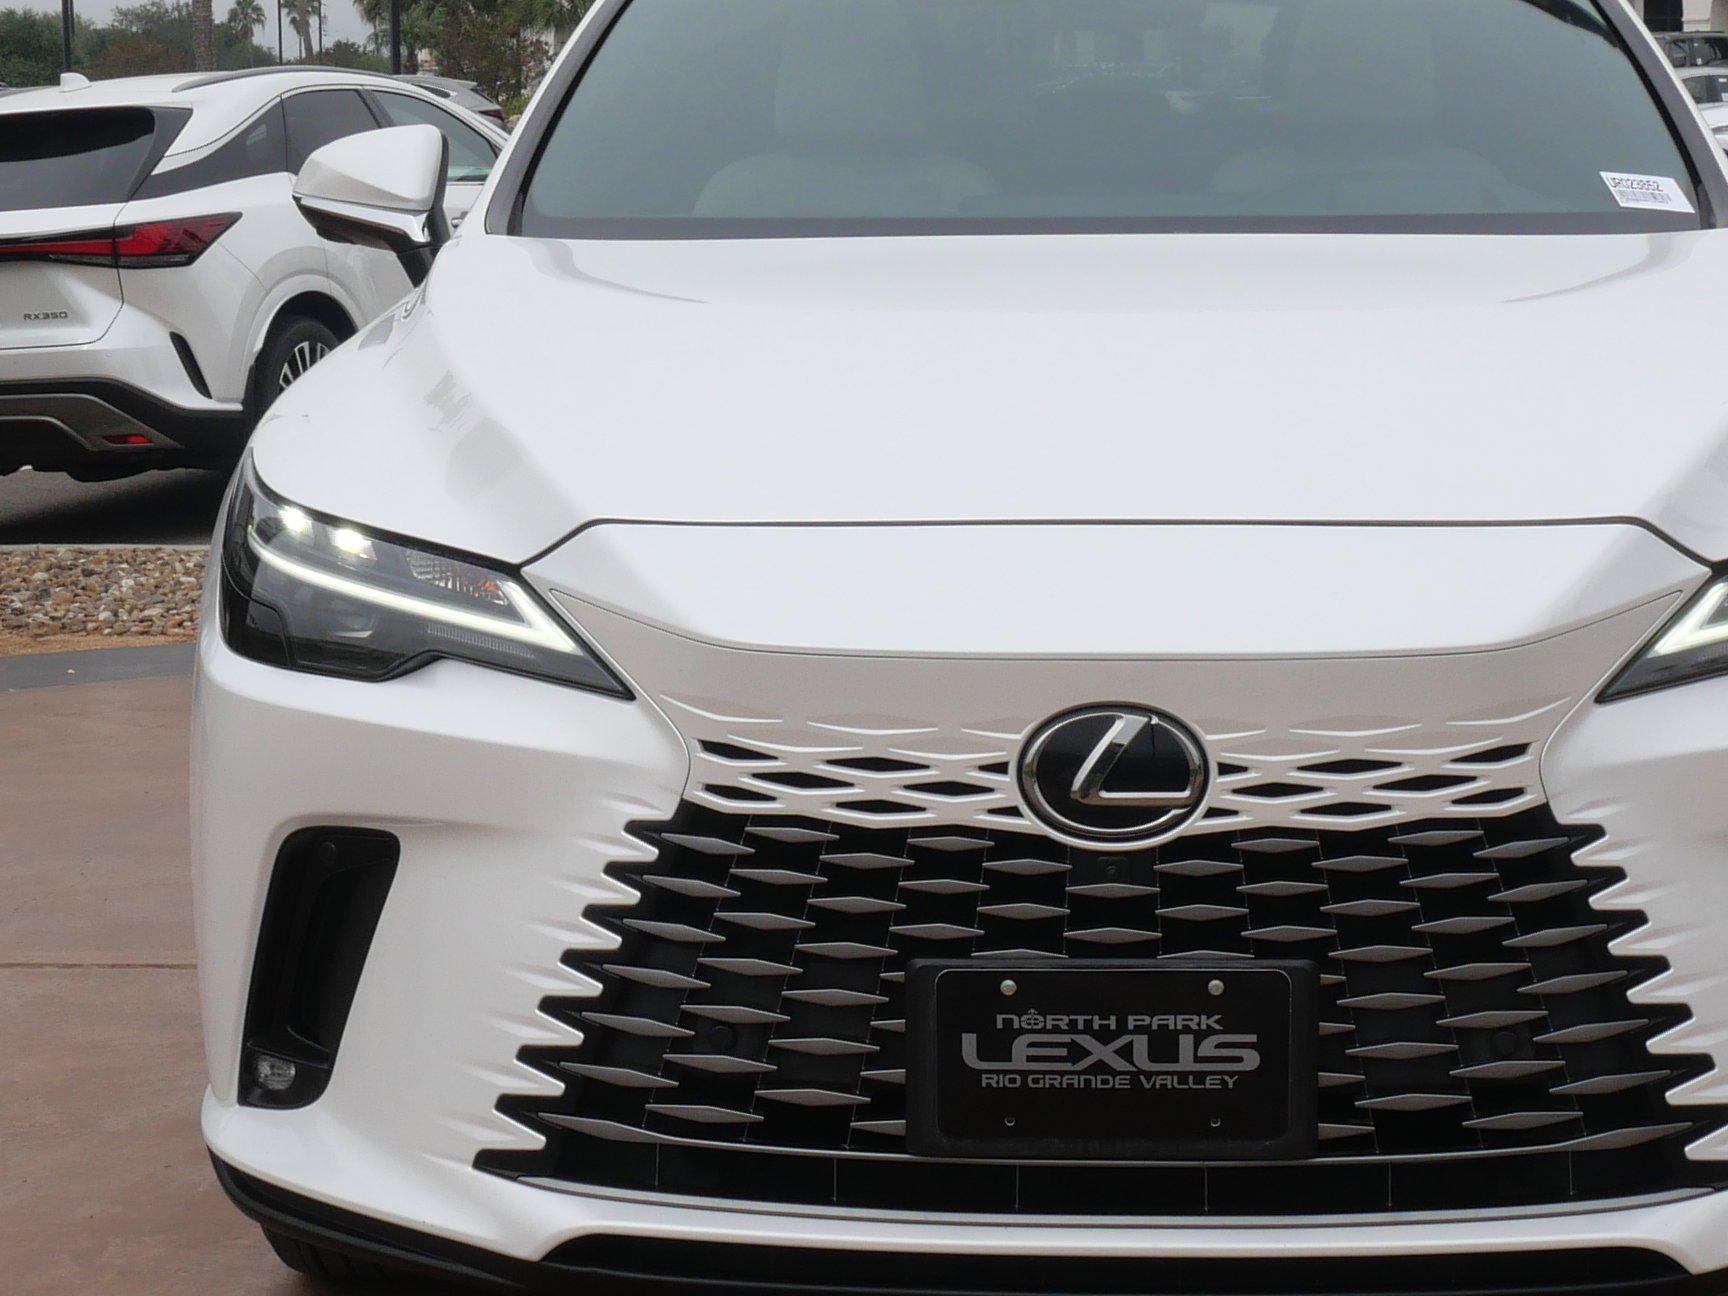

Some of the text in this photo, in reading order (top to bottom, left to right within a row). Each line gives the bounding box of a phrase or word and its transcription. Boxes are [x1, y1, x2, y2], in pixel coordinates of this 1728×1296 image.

[23, 311, 68, 321] RX350
[996, 1011, 1224, 1030] NORTH PARK
[961, 1032, 1261, 1072] LEXUS
[981, 1073, 1240, 1089] RIO GRANDE VALLEY
